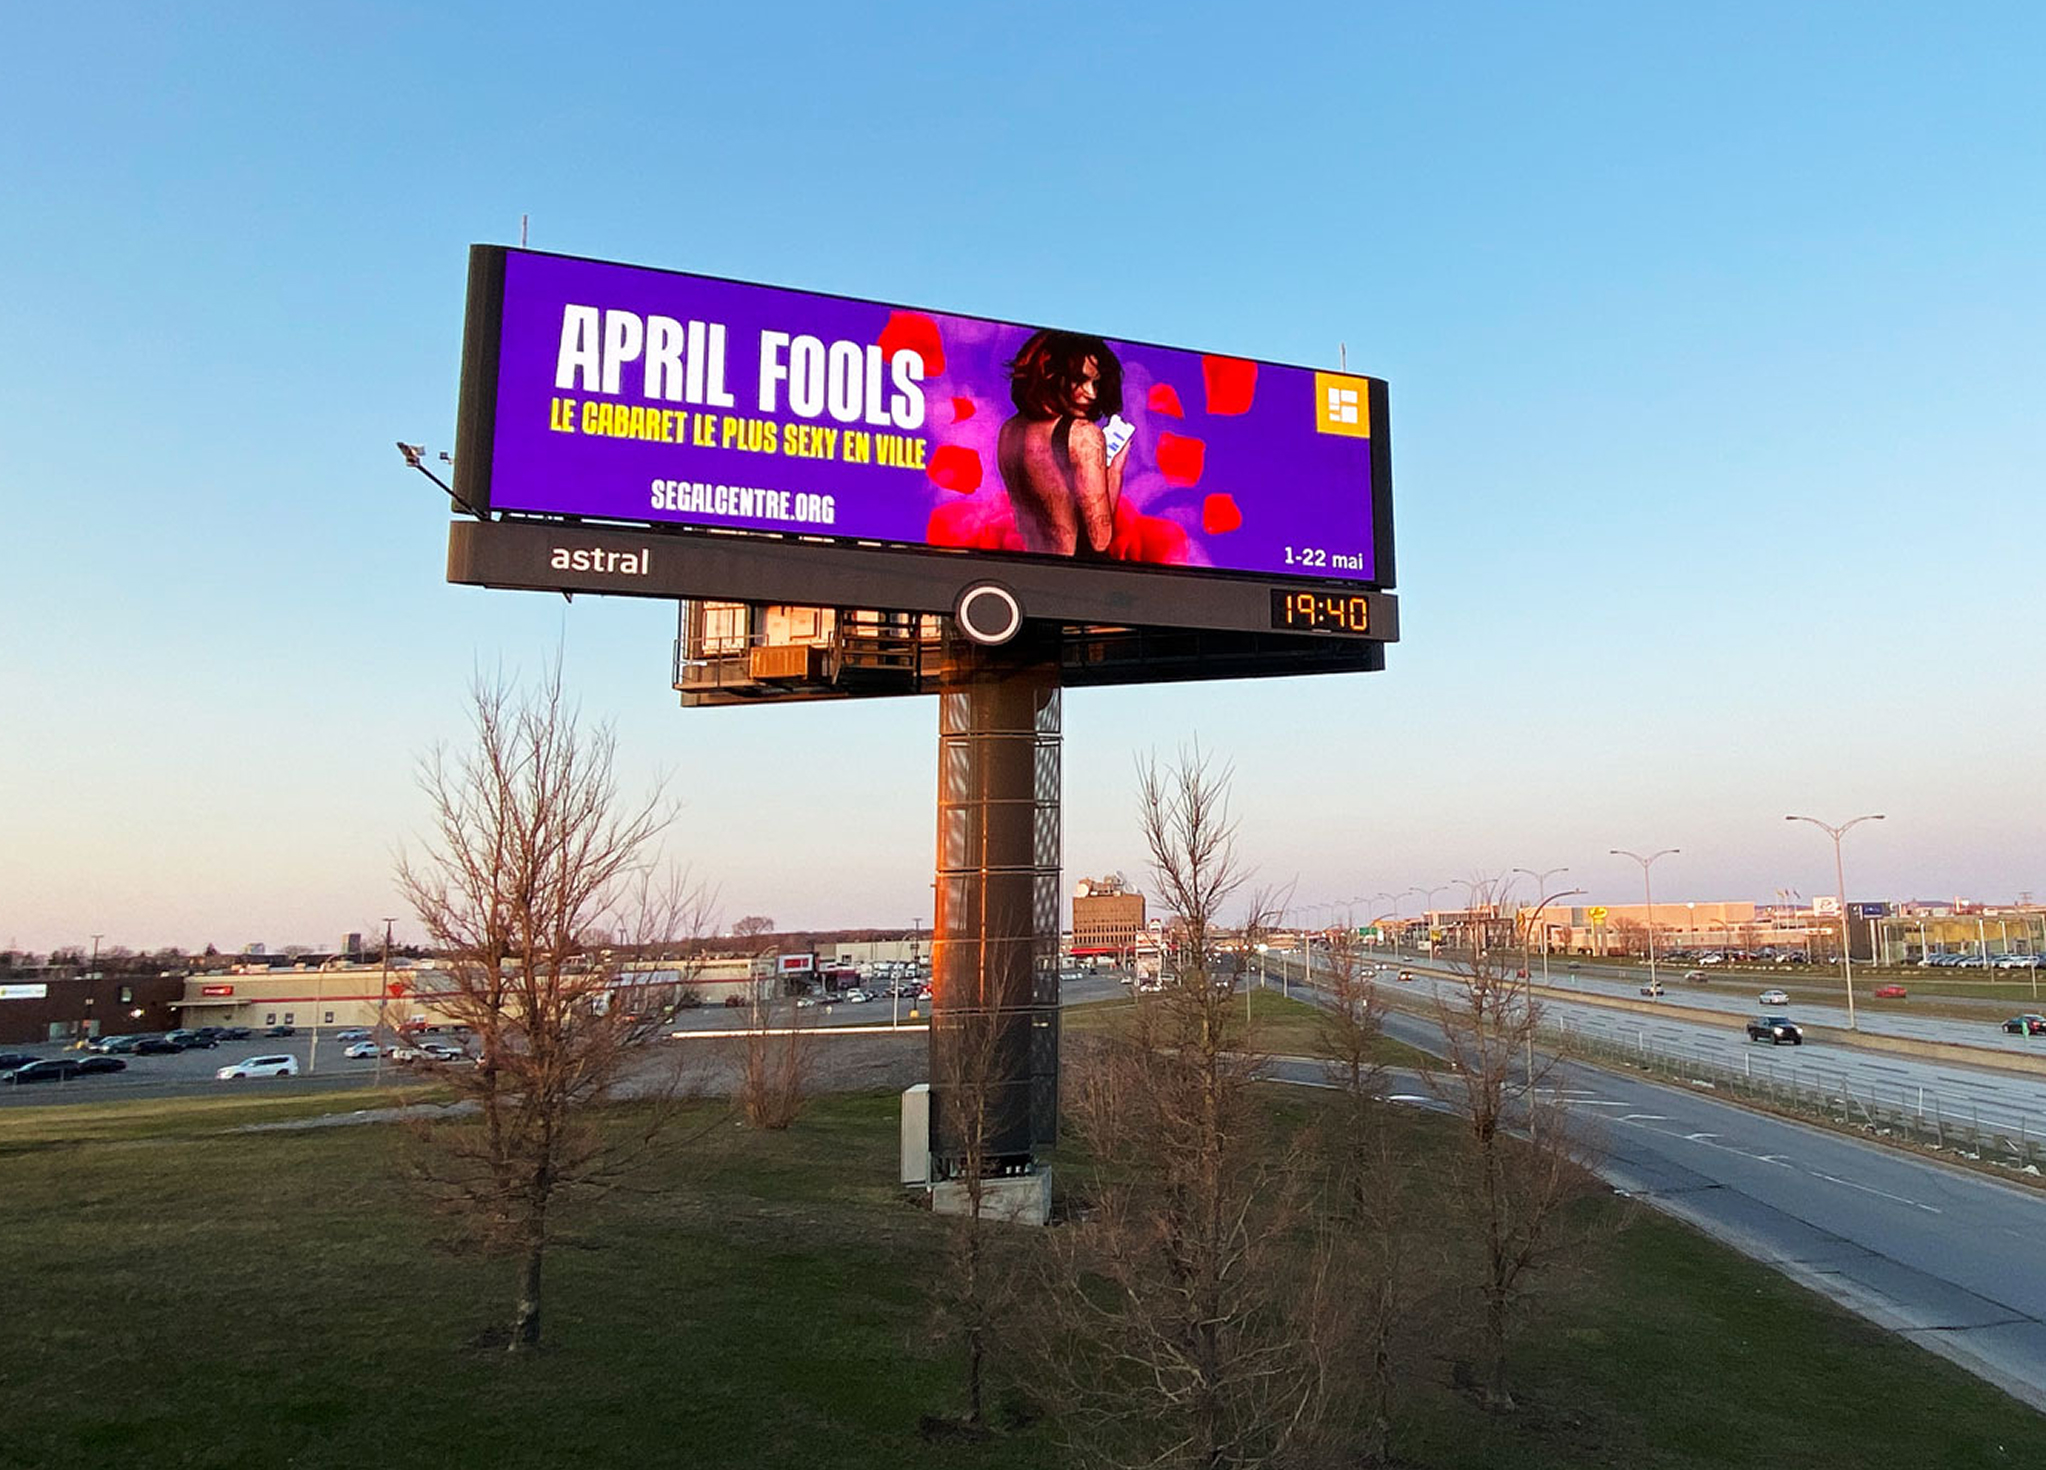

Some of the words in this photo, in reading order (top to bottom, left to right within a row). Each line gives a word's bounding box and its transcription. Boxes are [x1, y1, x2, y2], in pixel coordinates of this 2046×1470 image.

[555, 303, 734, 408] APRIL
[758, 329, 926, 430] FOOLS
[550, 397, 575, 433] LE
[581, 400, 687, 444] CABARET
[693, 413, 716, 447] LE
[722, 416, 778, 453] PLUS
[783, 422, 837, 459] SEXY
[843, 430, 870, 464] EN
[874, 434, 926, 469] VILLE
[650, 478, 835, 525] SEGALCENTRE.ORG
[550, 547, 649, 575] astral
[1285, 546, 1327, 567] 1-22
[1332, 552, 1363, 570] mai
[1286, 594, 1367, 631] 19:40
